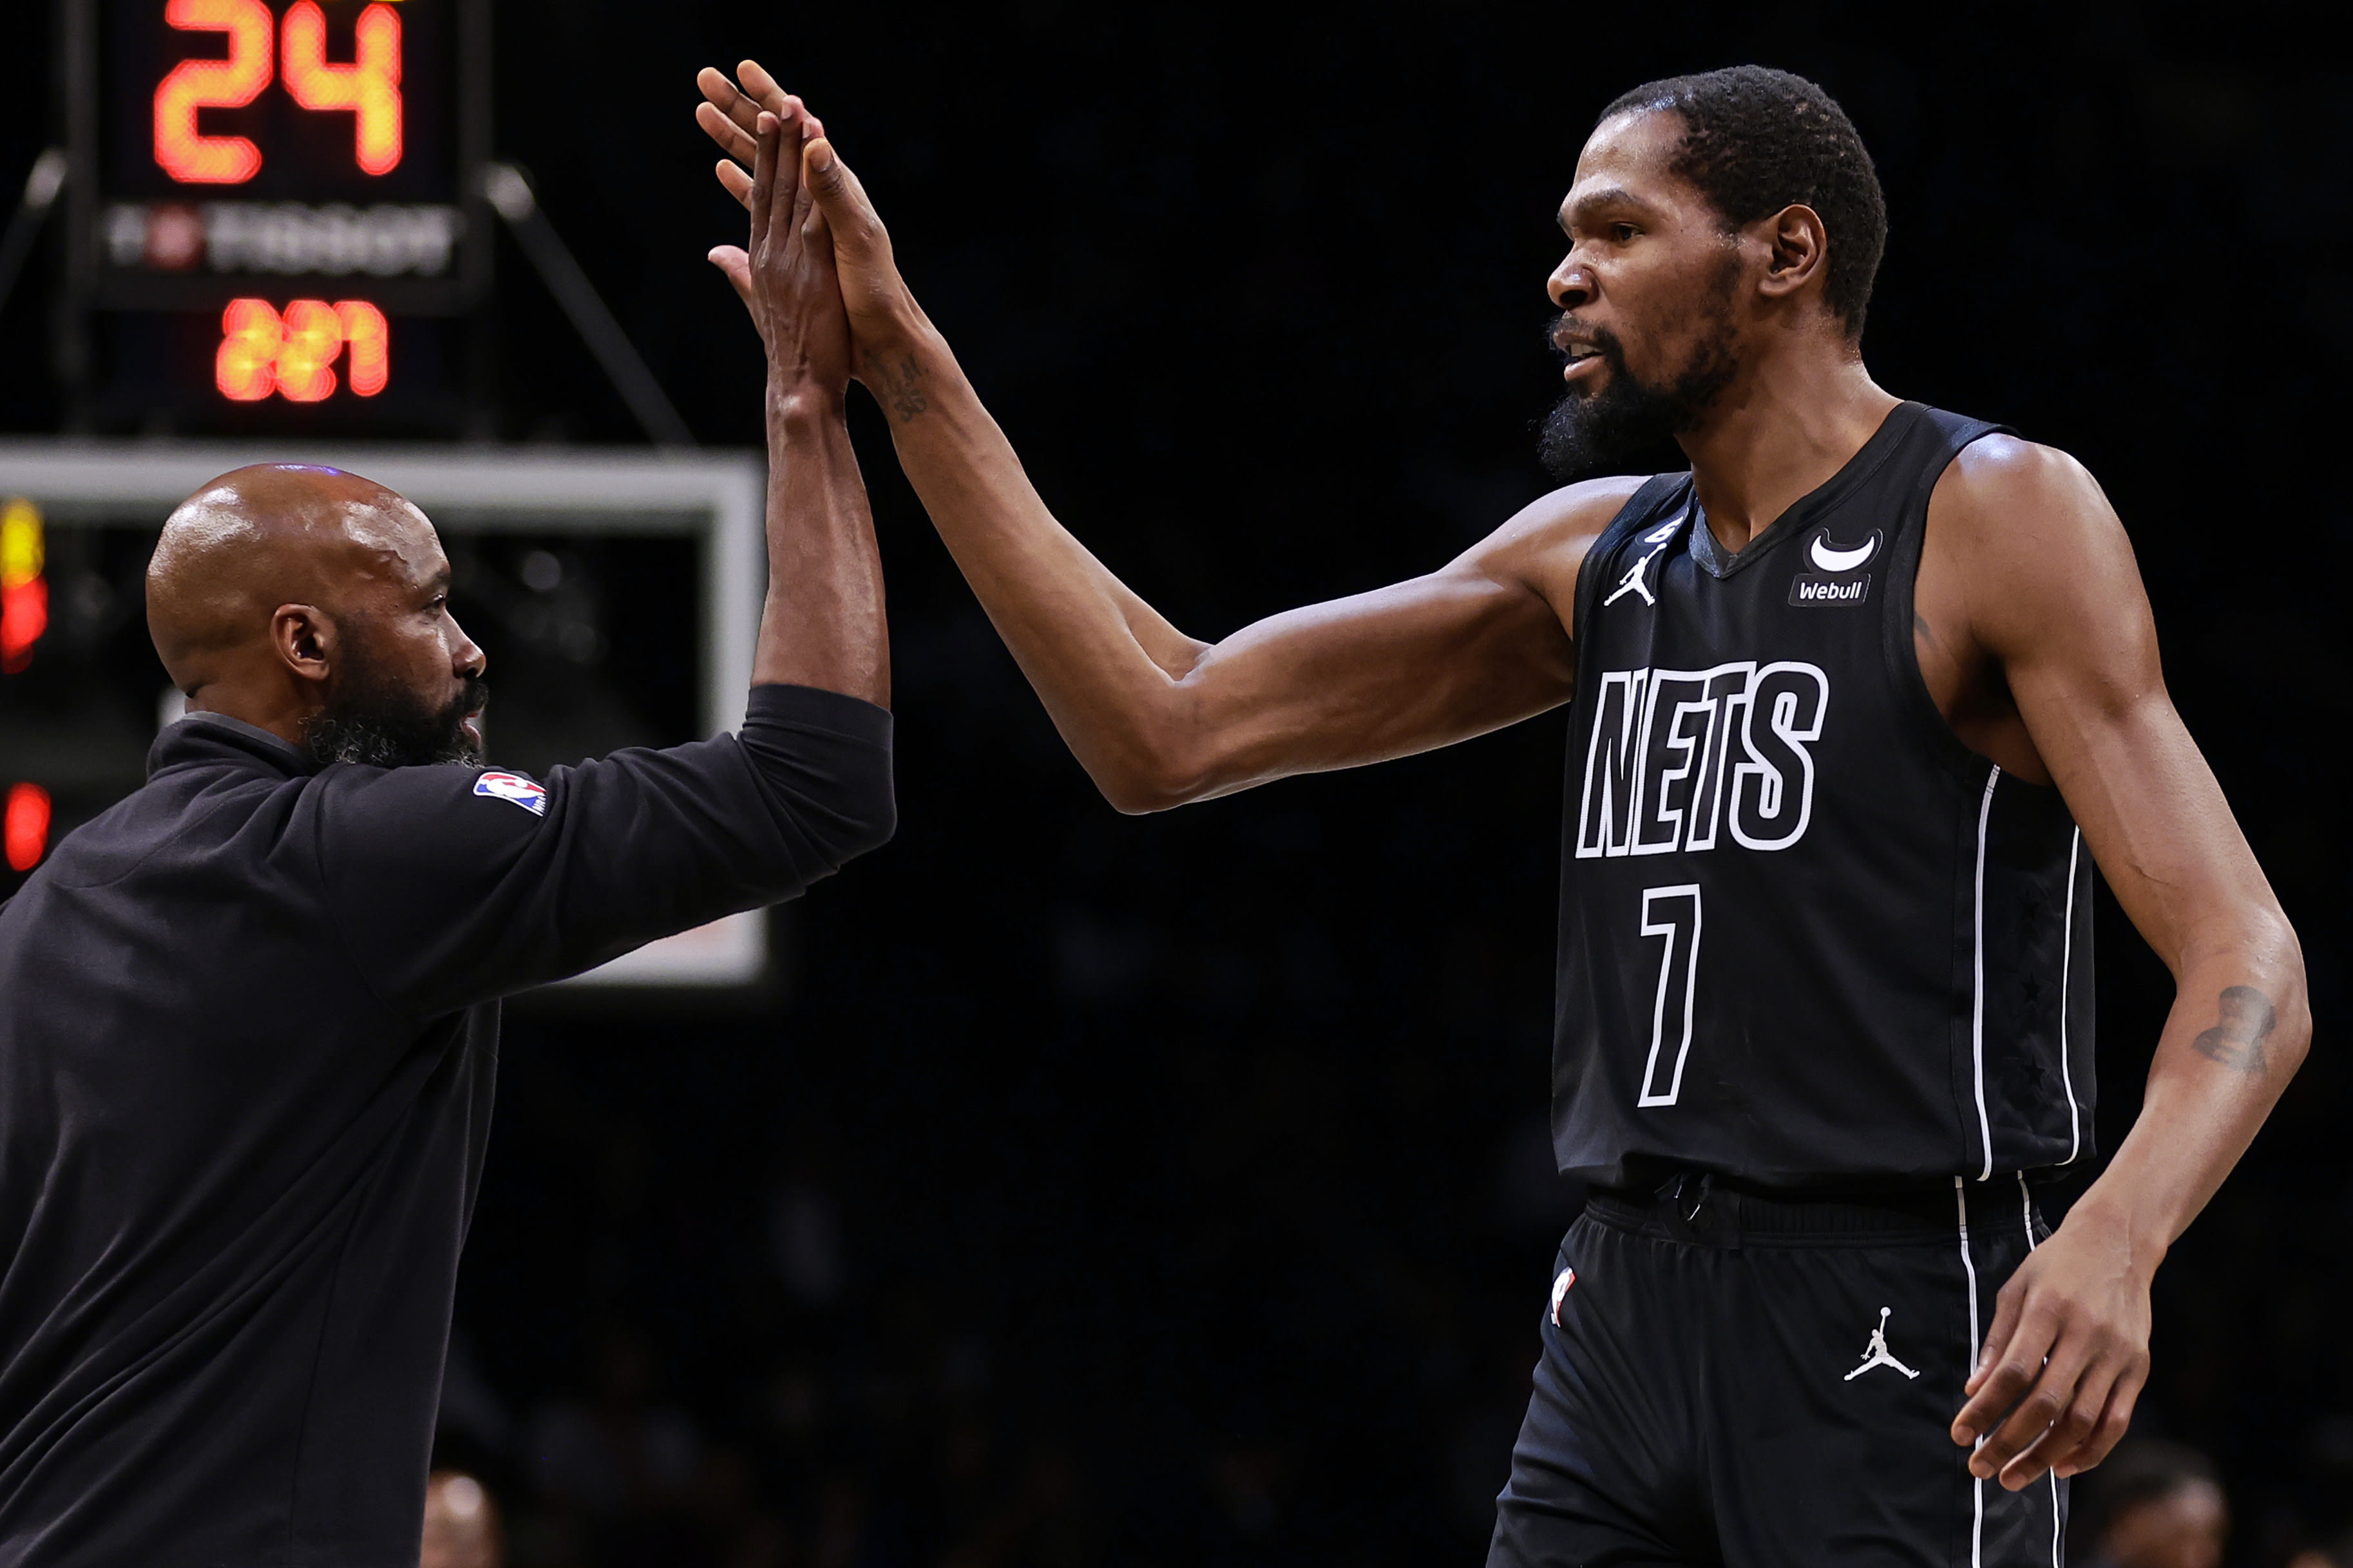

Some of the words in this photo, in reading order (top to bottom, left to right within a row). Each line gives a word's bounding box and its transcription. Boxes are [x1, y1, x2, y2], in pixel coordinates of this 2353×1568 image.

[153, 0, 402, 184] 24
[1799, 581, 1863, 600] Webull
[1575, 661, 1829, 859] NETS
[1637, 883, 1702, 1108] 7
